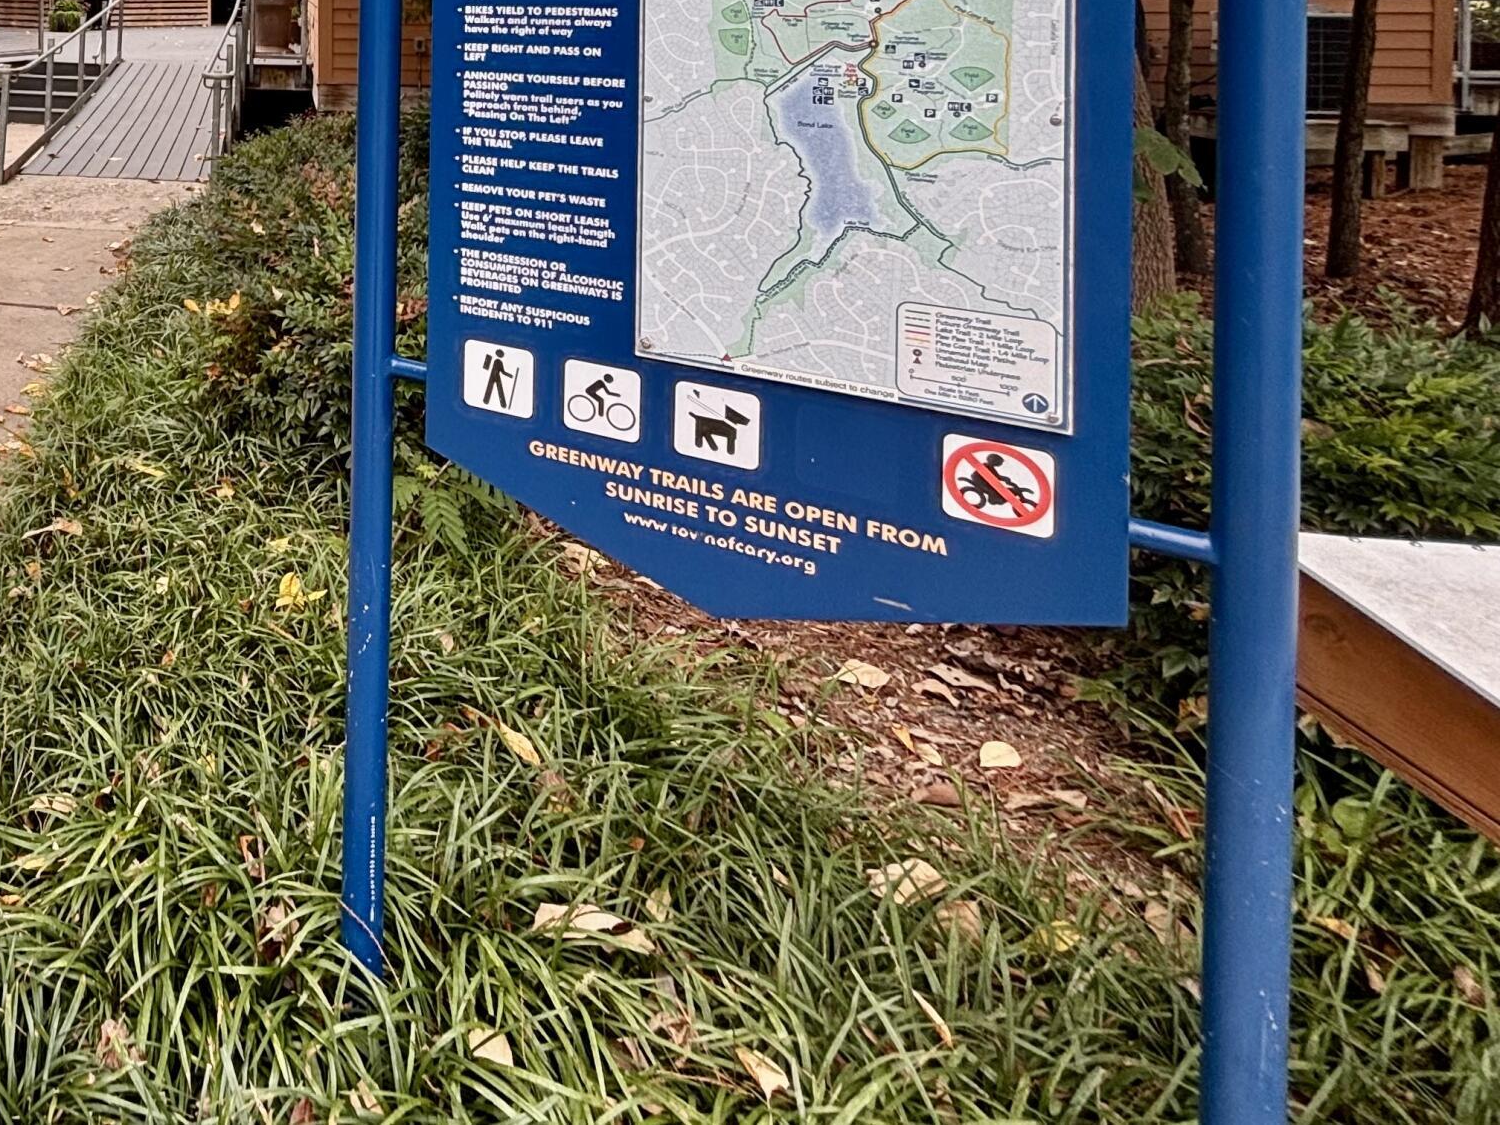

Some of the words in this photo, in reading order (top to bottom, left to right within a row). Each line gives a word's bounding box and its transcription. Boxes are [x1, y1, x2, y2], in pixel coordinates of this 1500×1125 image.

[465, 6, 493, 14] BIKES
[496, 7, 524, 15] YIELD
[527, 7, 542, 15] TO
[545, 7, 618, 16] PEDESTRIANS
[465, 16, 504, 24] Walkers
[508, 16, 527, 25] and
[530, 18, 571, 26] runners
[575, 17, 612, 27] always
[492, 26, 508, 34] the
[511, 26, 535, 36] right
[539, 27, 549, 35] of
[551, 29, 573, 37] way
[464, 43, 489, 52] KEEP
[492, 44, 523, 53] RIGHT
[526, 46, 549, 54] AND
[553, 47, 580, 56] PASS
[583, 48, 601, 56] ON
[464, 53, 486, 61] LEFT
[464, 71, 524, 82] ANNOUNCE
[527, 75, 579, 85] YOURSELF
[583, 77, 625, 87] BEFORE
[464, 81, 508, 91] PASSING
[463, 101, 510, 111] approach
[514, 102, 538, 112] from
[541, 104, 581, 116] behind,
[464, 90, 499, 102] Politely
[502, 94, 527, 102] warn
[531, 94, 553, 104] trail
[556, 97, 584, 105] users
[602, 100, 622, 109] you
[510, 112, 525, 121] On
[528, 113, 546, 122] The
[463, 127, 472, 135] IF
[475, 128, 496, 137] YOU
[530, 132, 566, 143] PLEASE
[570, 135, 603, 146] LEAVE
[463, 137, 481, 146] THE
[485, 138, 512, 148] TRAIL
[462, 155, 497, 166] PLEASE
[501, 158, 526, 168] HELP
[529, 161, 554, 171] KEEP
[558, 164, 578, 174] THE
[581, 166, 618, 178] TRAILS
[462, 165, 494, 175] CLEAN
[462, 183, 503, 195] REMOVE
[507, 188, 535, 199] YOUR
[569, 195, 605, 207] WASTE
[462, 202, 486, 212] KEEP
[489, 205, 512, 215] PETS
[515, 208, 532, 217] ON
[535, 211, 571, 222] SHORT
[574, 215, 609, 227] LEASH
[461, 220, 486, 231] Walk
[489, 225, 512, 237] pets
[515, 228, 526, 236] on
[529, 228, 546, 239] the
[549, 232, 607, 248] right-hand
[462, 212, 479, 221] Use
[495, 217, 545, 229] maximum
[548, 221, 576, 233] leash
[580, 225, 615, 240] length
[461, 230, 505, 243] shoulder
[461, 248, 479, 258] THE
[483, 251, 547, 268] POSSESSION
[550, 261, 566, 271] OR
[461, 258, 539, 276] CONSUMPTION
[542, 269, 556, 279] OF
[560, 272, 623, 291] ALCOHOLIC
[461, 267, 518, 283] BEVERAGES
[521, 276, 538, 287] ON
[542, 279, 608, 298] GREENWAYS
[612, 291, 622, 300] IS
[460, 276, 521, 294] PROHIBITED
[460, 295, 497, 308] REPORT
[501, 301, 522, 312] ANY
[526, 305, 590, 325] SUSPICIOUS
[460, 305, 514, 321] INCIDENTS
[517, 313, 531, 323] TO
[534, 316, 552, 328] 911
[741, 364, 784, 378] Greenway
[786, 373, 812, 383] routes
[815, 379, 846, 391] subject
[860, 386, 894, 398] change
[529, 440, 644, 480] GREENWAY
[649, 468, 724, 502] TRAILS
[731, 487, 777, 513] ARE
[785, 500, 857, 534] OPEN
[866, 518, 948, 556] FROM
[606, 481, 699, 518] SUNRISE
[706, 505, 737, 528] TO
[744, 515, 841, 555] SUNSET
